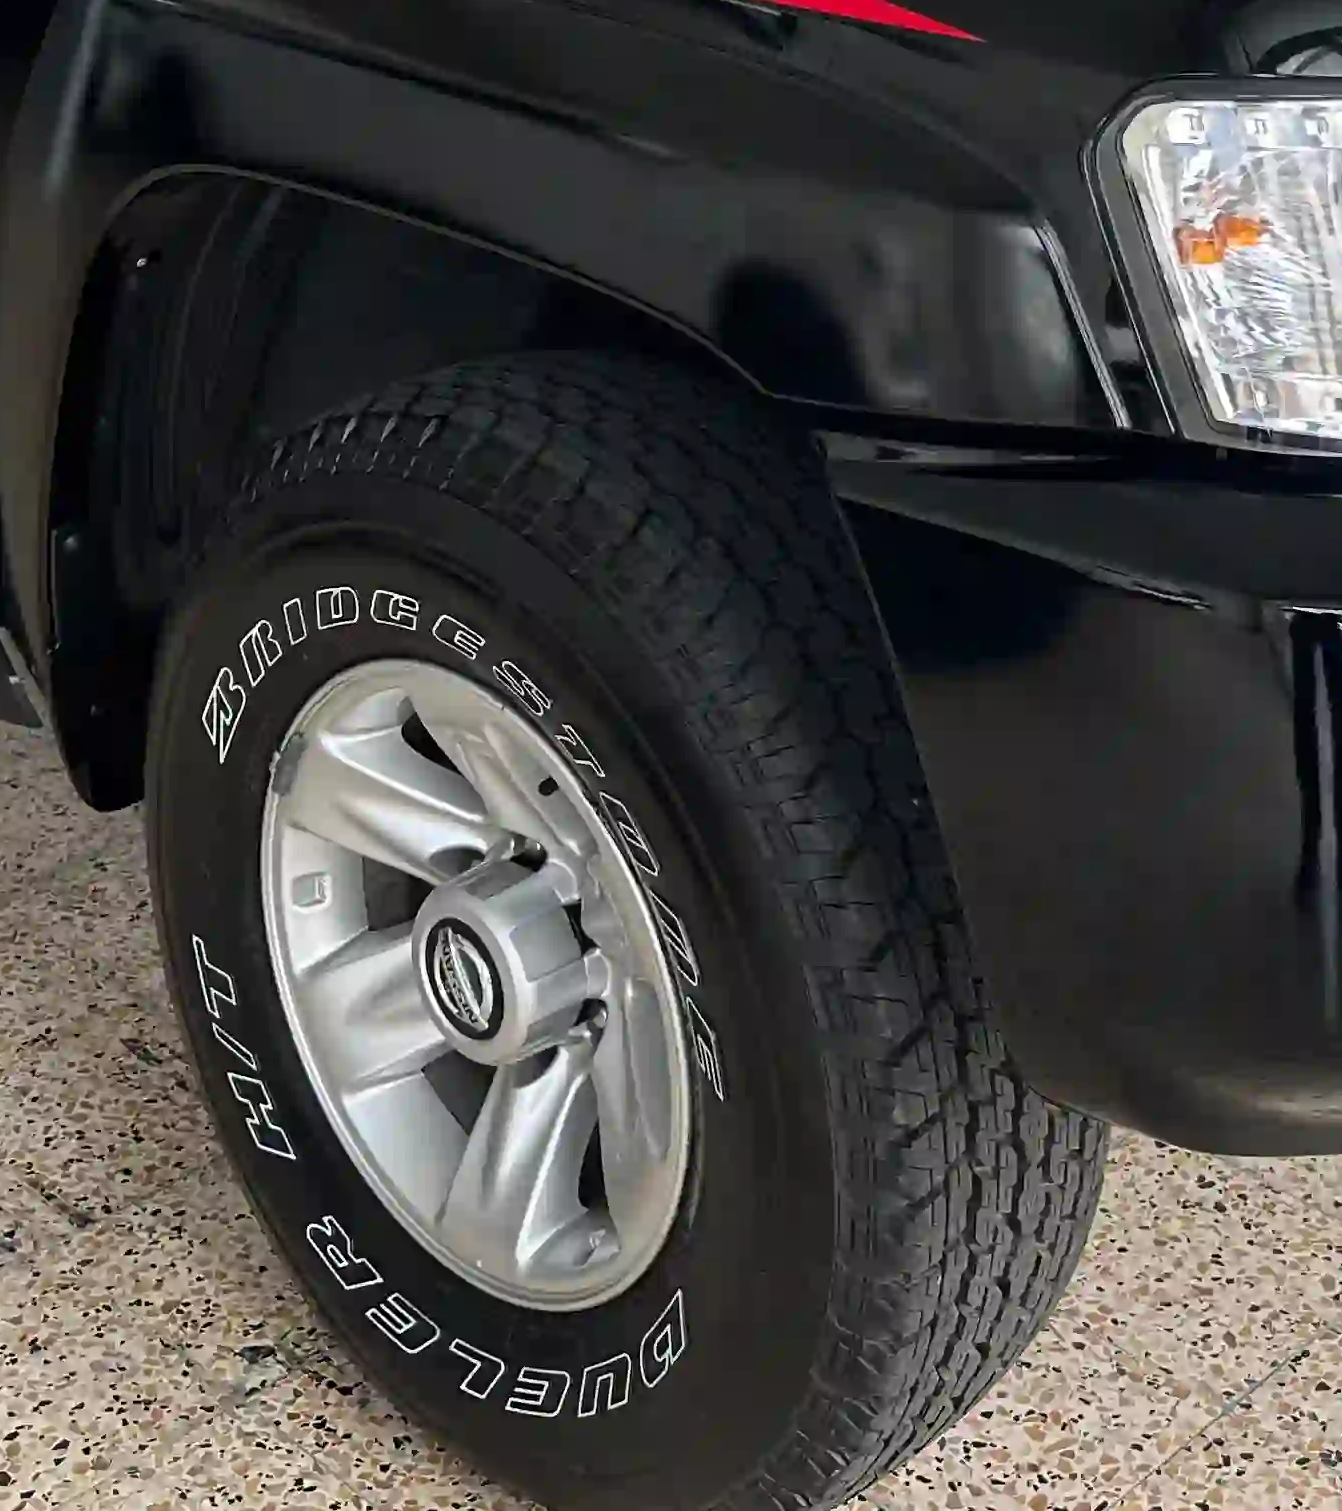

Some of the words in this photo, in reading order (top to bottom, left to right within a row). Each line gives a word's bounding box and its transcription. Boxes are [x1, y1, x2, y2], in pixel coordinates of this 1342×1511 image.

[201, 586, 725, 1102] BRIDGESTONE
[192, 934, 297, 1161] H/T
[306, 1215, 688, 1418] DUELER
